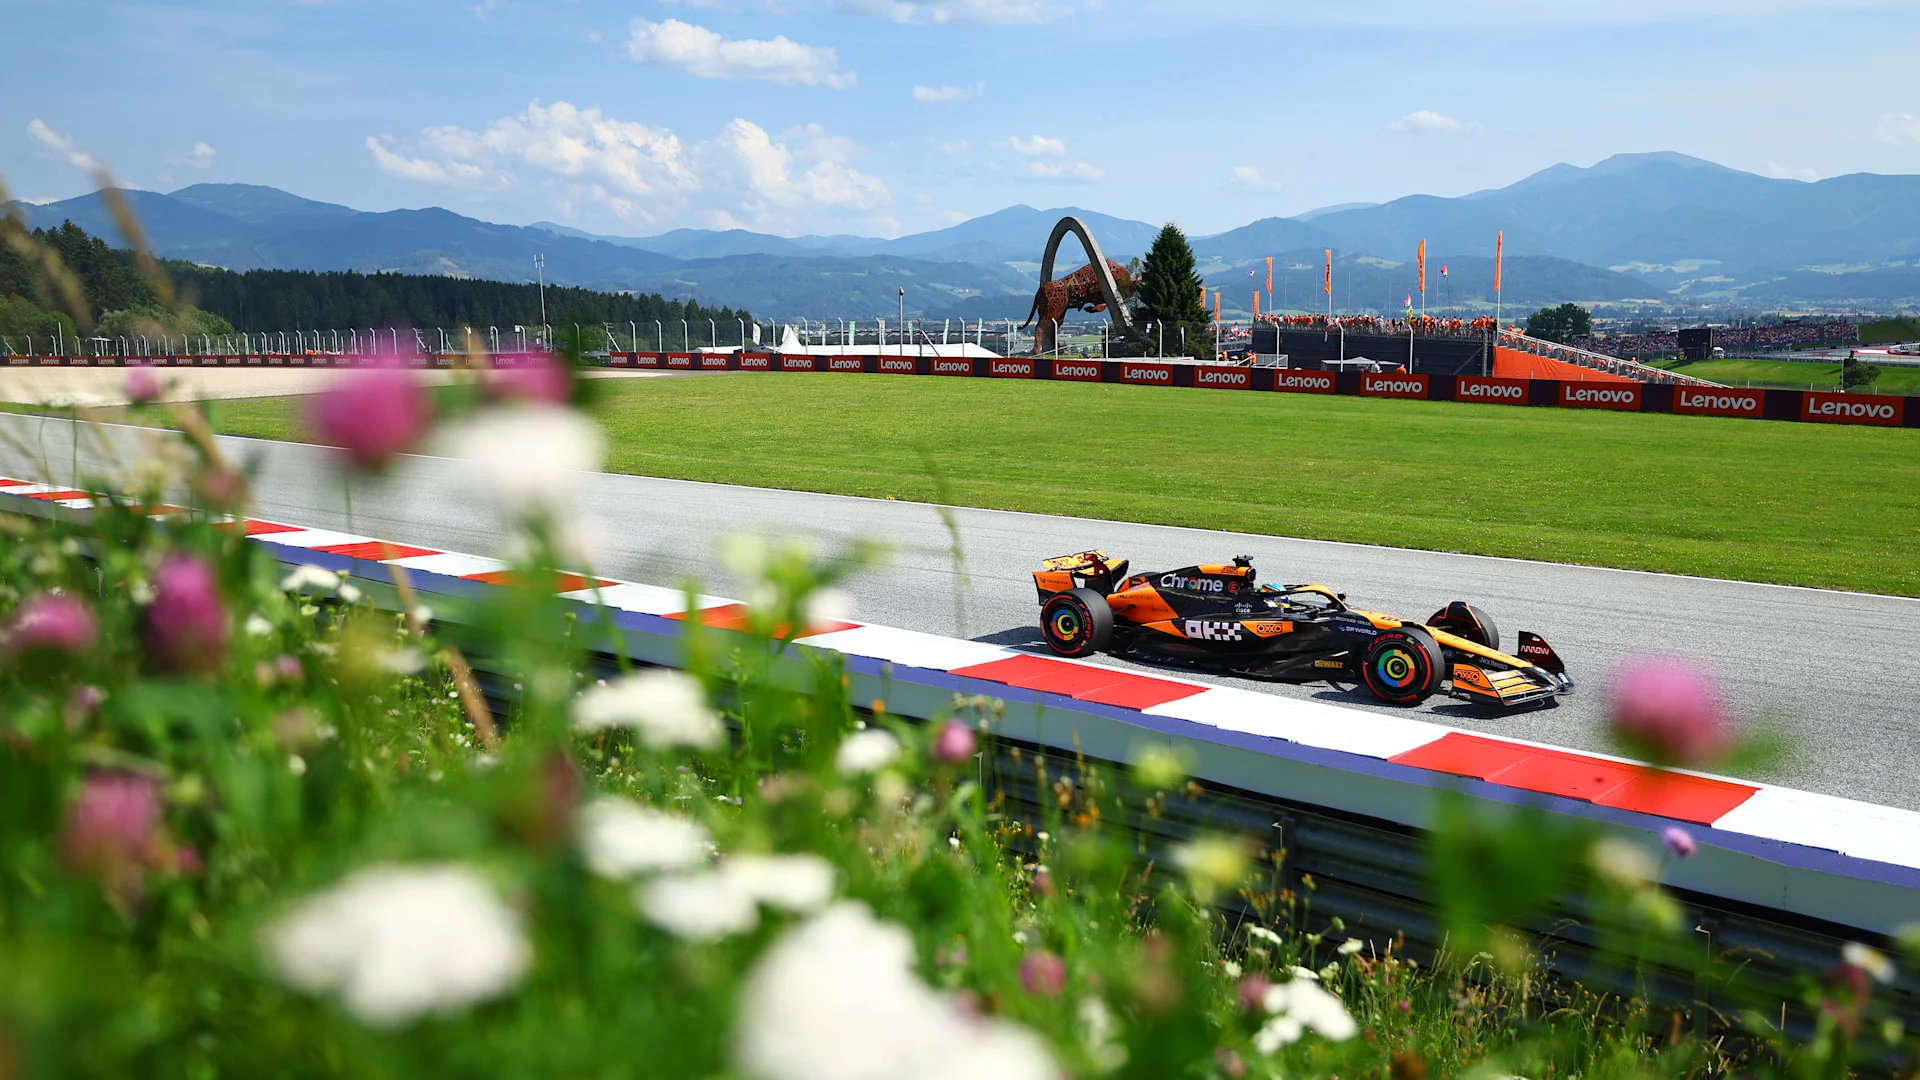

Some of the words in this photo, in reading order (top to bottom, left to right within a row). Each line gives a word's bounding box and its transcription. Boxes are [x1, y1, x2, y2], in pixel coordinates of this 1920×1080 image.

[247, 356, 261, 364] Lenovo
[290, 356, 304, 364] Lenovo
[437, 357, 454, 365] Lenovo
[466, 357, 484, 365] Lenovo
[610, 355, 627, 364] Lenovo
[637, 355, 657, 364] Lenovo
[668, 356, 690, 365] Lenovo
[702, 356, 727, 366] Lenovo
[740, 357, 768, 367] Lenovo
[783, 357, 813, 367] Lenovo
[829, 358, 861, 369] Lenovo
[880, 359, 913, 370] Lenovo
[934, 360, 970, 372] Lenovo
[992, 362, 1031, 374] Lenovo
[1055, 364, 1098, 377] Lenovo
[1124, 366, 1169, 380] Lenovo
[1198, 369, 1246, 384] Lenovo
[1278, 373, 1331, 388] Lenovo
[1366, 377, 1423, 393] Lenovo
[1461, 381, 1523, 398] Lenovo
[1566, 385, 1634, 403] Lenovo
[1680, 391, 1756, 410] Lenovo
[1808, 397, 1895, 418] Lenovo
[1160, 573, 1224, 592] Chrome
[1185, 620, 1242, 641] OKX
[1257, 625, 1283, 633] OXXO
[1520, 645, 1550, 655] ARROW
[1454, 670, 1480, 681] OXXO
